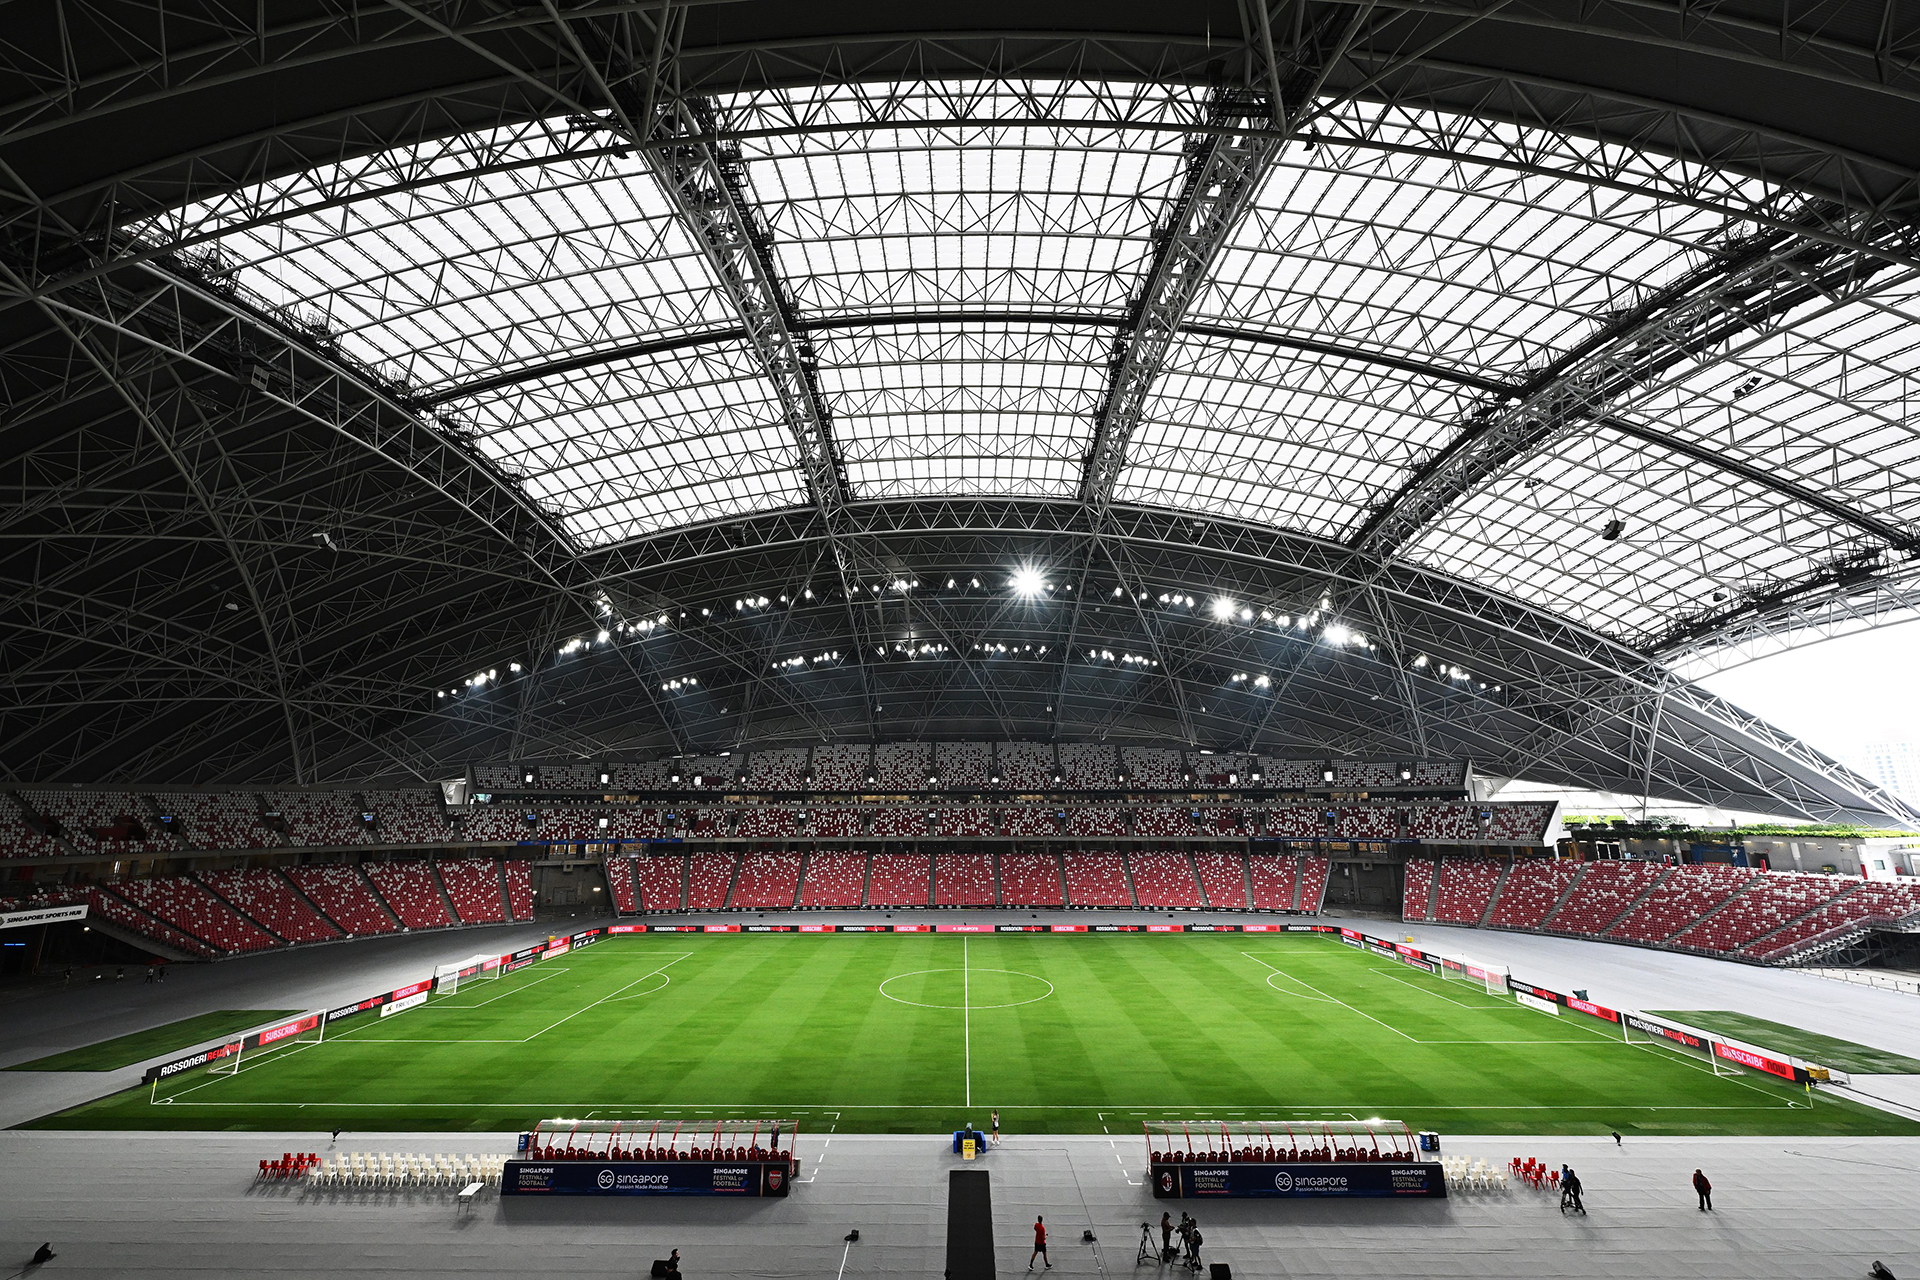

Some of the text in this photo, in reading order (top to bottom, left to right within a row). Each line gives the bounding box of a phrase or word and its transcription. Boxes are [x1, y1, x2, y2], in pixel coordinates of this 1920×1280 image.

[7, 914, 44, 923] SINGAPORE
[45, 911, 69, 919] SPORTS
[396, 984, 418, 998] SUBSCRIBE
[329, 1004, 359, 1020] ROSSONERI
[1570, 998, 1598, 1014] SUBSCRIBE
[265, 1023, 298, 1042] SUBSCRIBE
[161, 1053, 208, 1077] ROSSONERI
[1722, 1046, 1764, 1069] SUBSCRIBE
[600, 1175, 612, 1184] SG
[1278, 1178, 1290, 1186] SG
